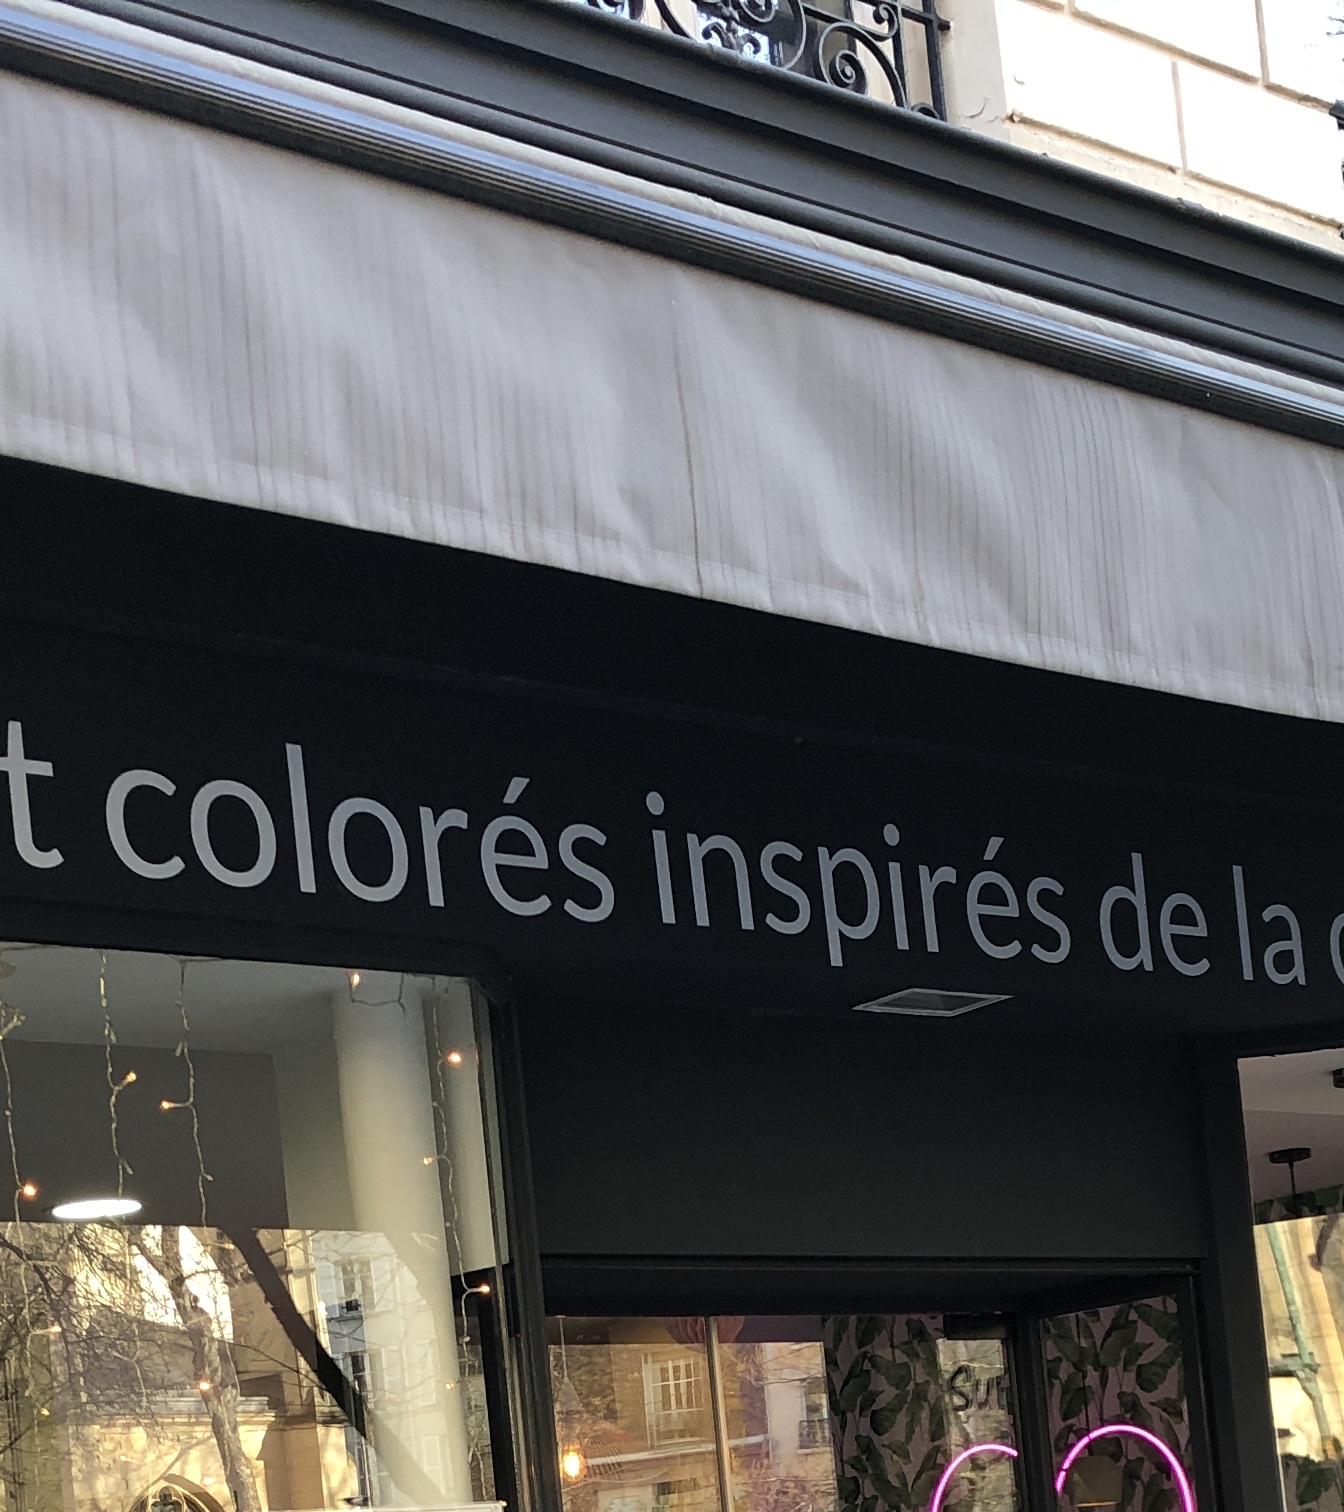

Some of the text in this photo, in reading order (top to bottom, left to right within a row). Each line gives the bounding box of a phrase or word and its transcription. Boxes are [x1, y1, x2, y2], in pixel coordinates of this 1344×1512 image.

[104, 742, 615, 923] colorés
[644, 790, 1072, 967] inspirés
[1099, 852, 1211, 981] de
[1231, 865, 1307, 986] la
